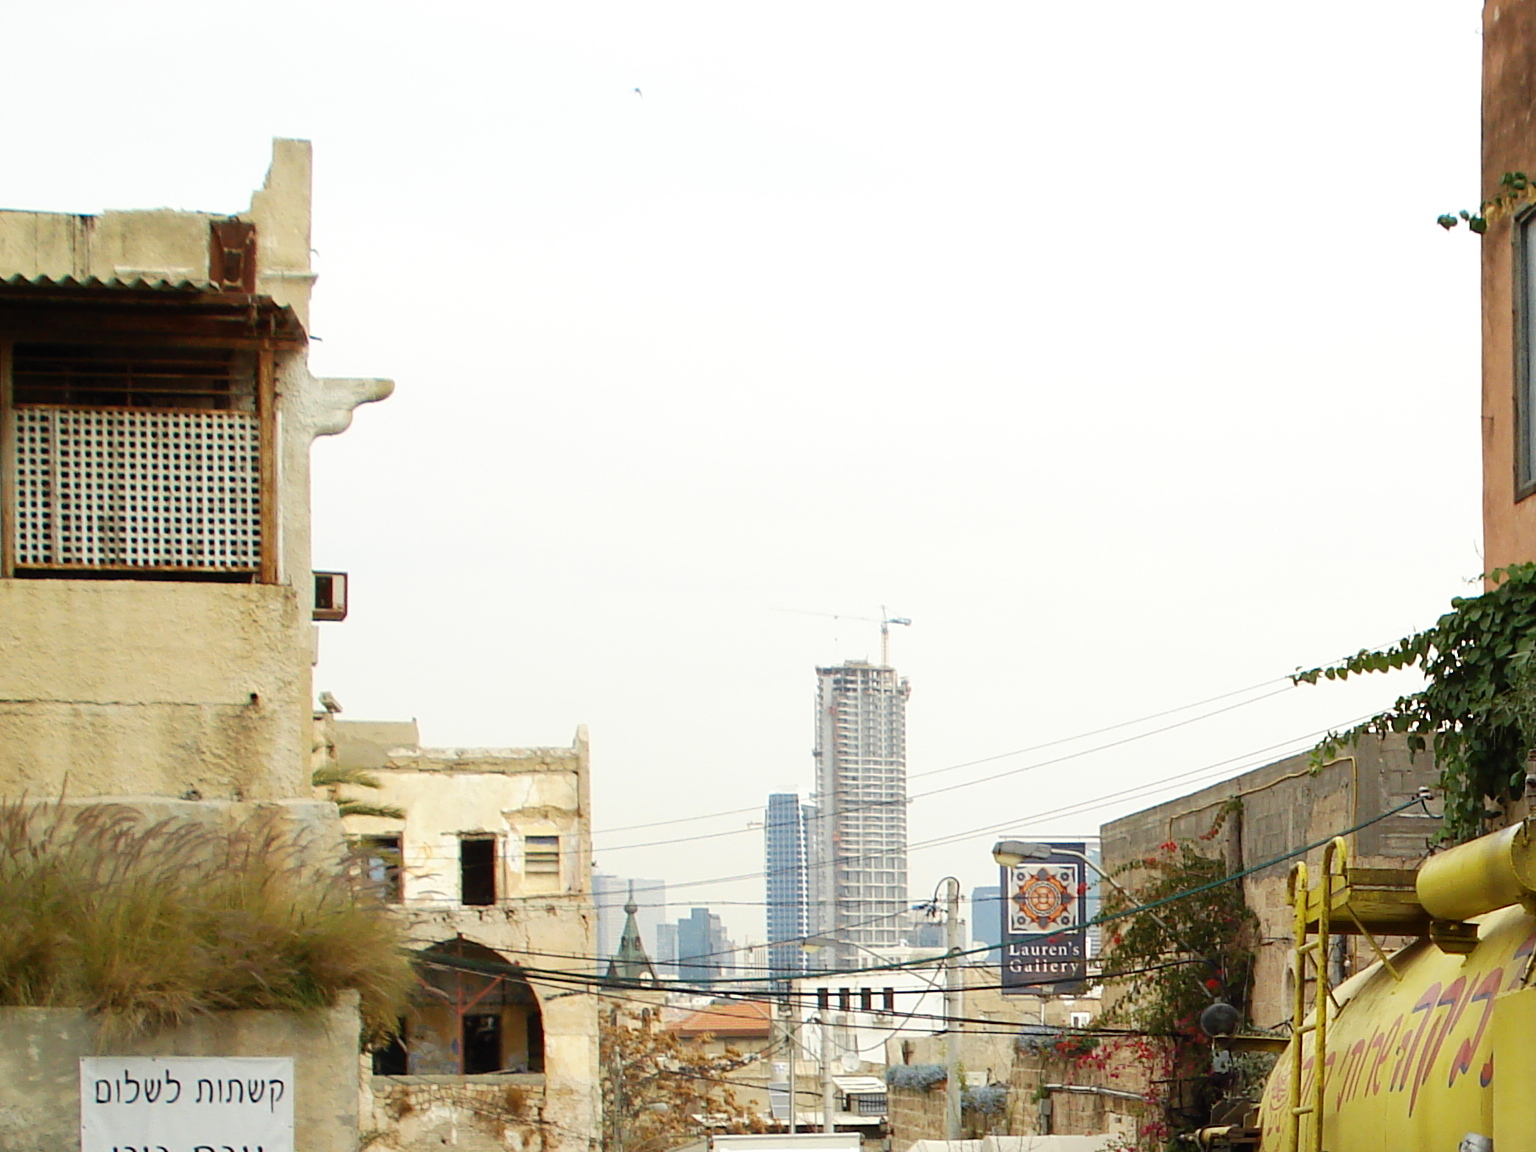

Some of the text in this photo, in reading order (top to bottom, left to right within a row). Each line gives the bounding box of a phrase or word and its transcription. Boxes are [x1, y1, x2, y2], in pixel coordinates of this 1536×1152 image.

[1009, 941, 1080, 956] Lauren's
[1009, 959, 1079, 976] Gallery
[95, 1069, 285, 1113] קשתות לשלום
